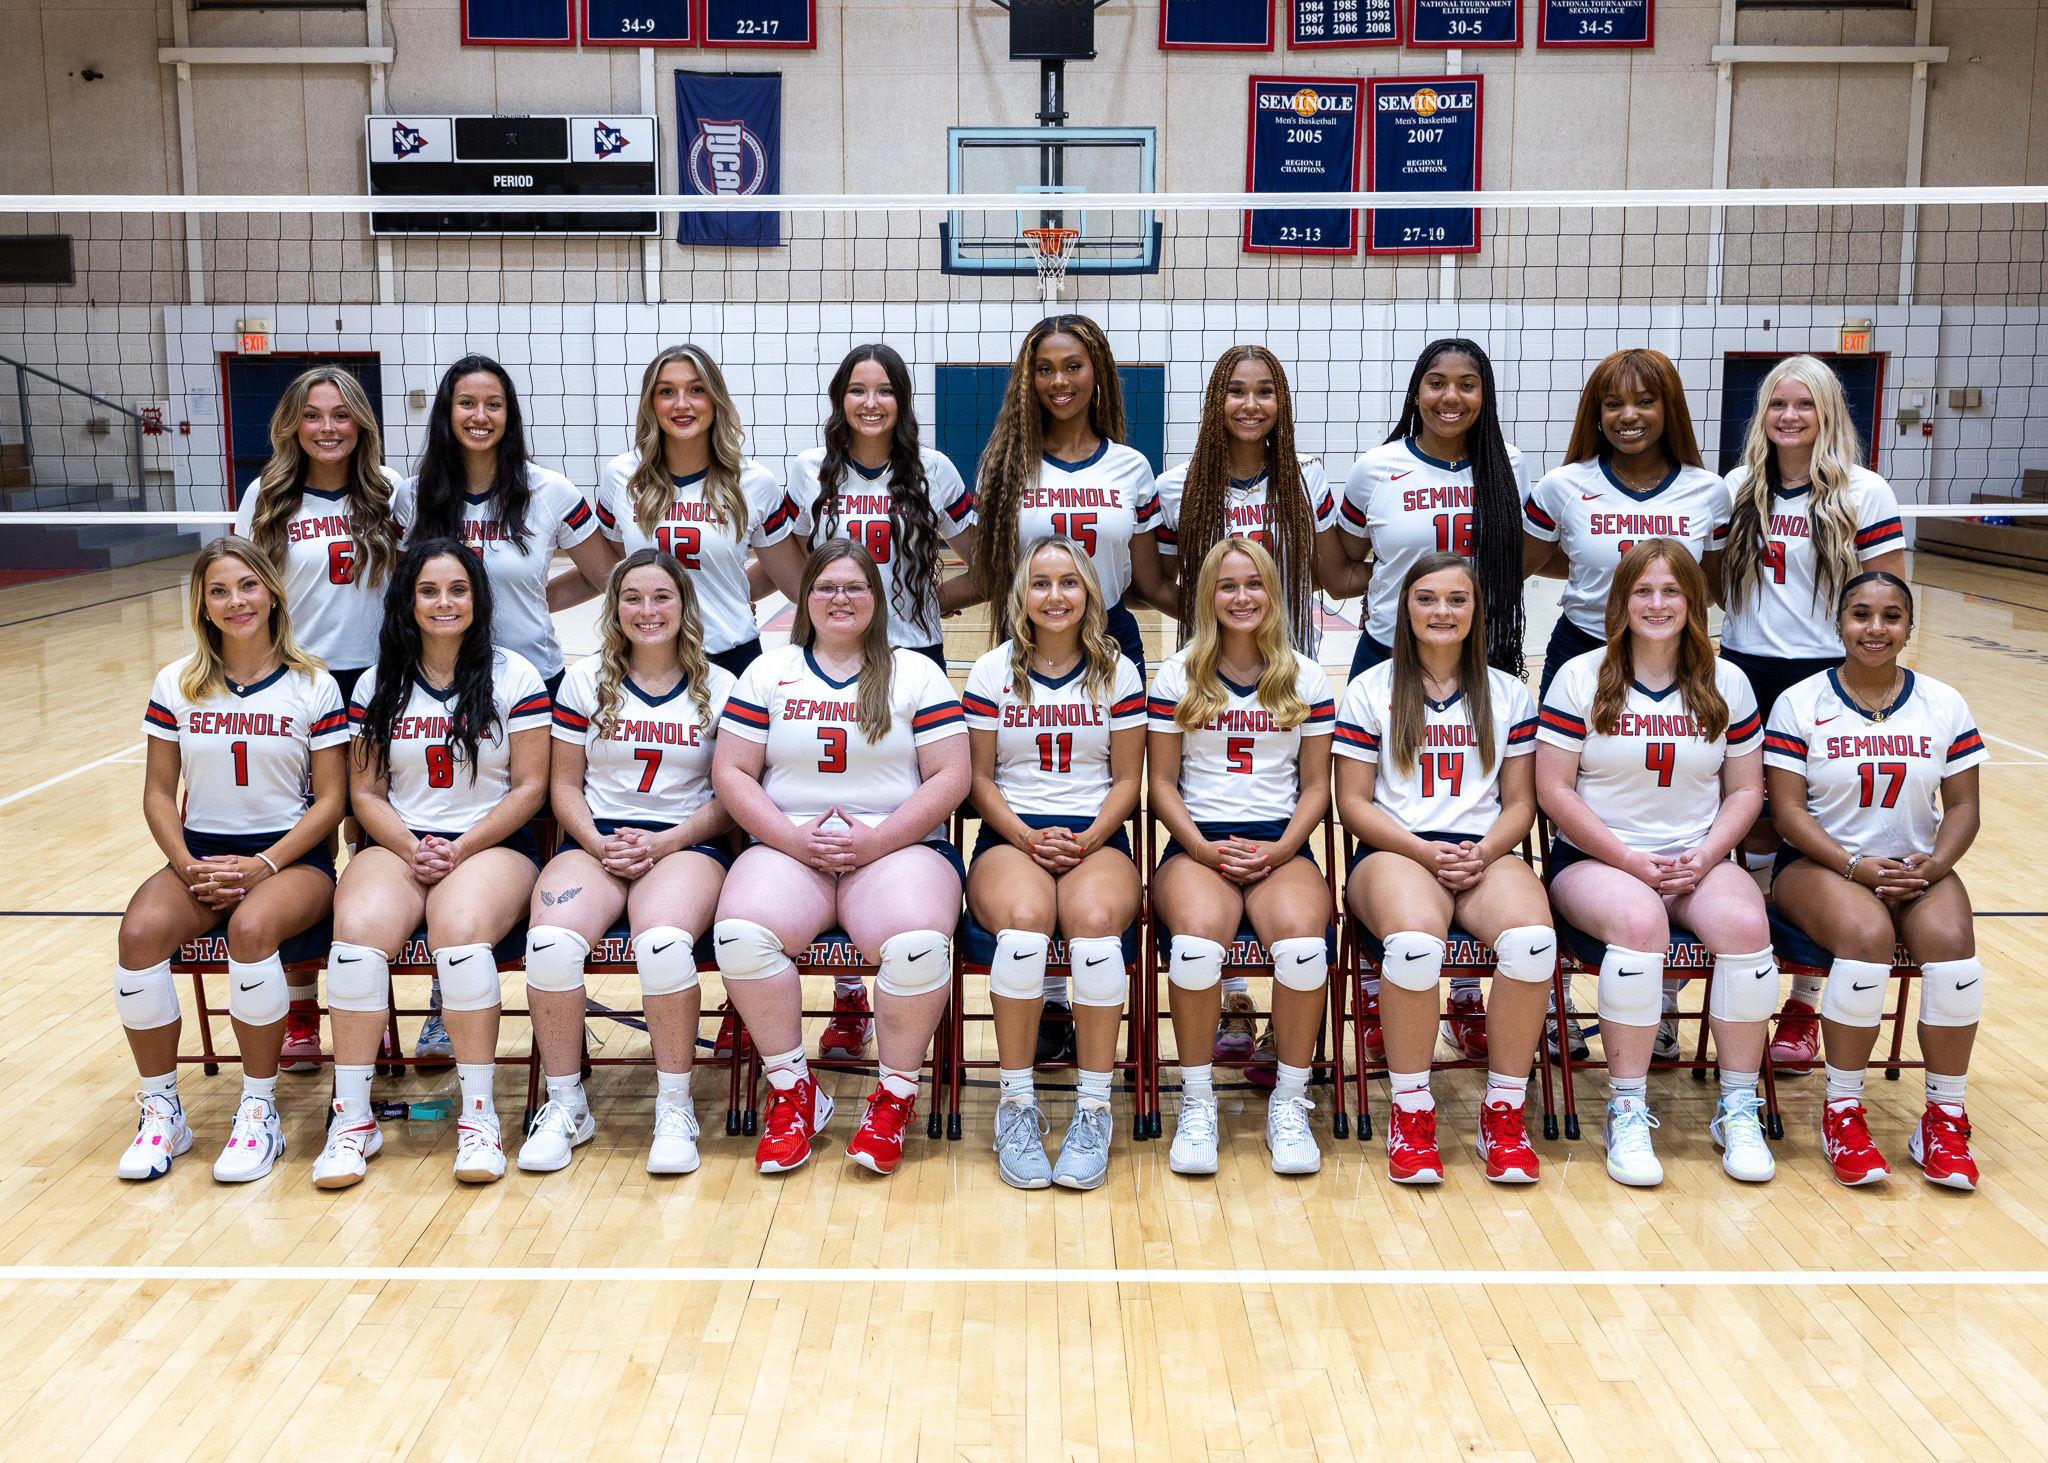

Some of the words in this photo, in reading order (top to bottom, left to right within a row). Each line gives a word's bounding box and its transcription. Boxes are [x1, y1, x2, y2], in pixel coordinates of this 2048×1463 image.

[1300, 2, 1324, 11] 1984
[1333, 0, 1357, 10] 1985
[1366, 0, 1390, 9] 1986
[1300, 13, 1324, 24] 1987
[1333, 12, 1357, 22] 1988
[1366, 10, 1390, 21] 1992
[621, 18, 655, 33] 34-9
[736, 20, 779, 35] 22-17
[1300, 25, 1324, 35] 1996
[1333, 24, 1358, 34] 2006
[1365, 23, 1391, 33] 2008
[1448, 20, 1482, 34] 30-5
[1579, 20, 1613, 34] 34-5
[1259, 94, 1353, 111] SEMINOLE
[1378, 93, 1473, 111] SEMINOLE
[1275, 117, 1297, 125] Men's
[1298, 117, 1337, 125] Basketball
[1394, 116, 1417, 125] Men's
[1418, 115, 1458, 124] Basketball
[1286, 129, 1323, 143] 2005
[1407, 129, 1444, 143] 2007
[1285, 159, 1314, 167] REGION
[1402, 165, 1448, 174] CHAMPIONS
[1406, 159, 1435, 167] REGION
[493, 175, 534, 188] PERIOD
[1280, 226, 1322, 241] 23-13
[1403, 226, 1445, 241] 27-10
[243, 335, 265, 351] EXIT
[1843, 334, 1866, 350] EXIT
[1023, 488, 1123, 509] SEMINOLE
[1403, 486, 1475, 512] SEMIN
[288, 515, 354, 542] SEMIN
[1051, 512, 1097, 558] 15
[1433, 513, 1474, 556] 16
[1591, 513, 1690, 536] SEMINOLE
[655, 526, 702, 570] 12
[847, 520, 893, 564] 18
[328, 541, 354, 585] 6
[783, 699, 860, 722] SEMINO
[1003, 704, 1103, 728] SEMINOLE
[189, 712, 294, 737] SEMINOLE
[817, 726, 847, 773] 3
[1035, 732, 1073, 774] 11
[1226, 737, 1255, 775] 5
[1827, 735, 1932, 759] SEMINOLE
[231, 741, 249, 787] 1
[425, 745, 454, 788] 8
[634, 748, 663, 793] 7
[1419, 752, 1464, 798] 14
[1645, 742, 1676, 788] 4
[1857, 762, 1907, 808] 17
[180, 937, 230, 962] STA
[796, 942, 882, 967] STAT
